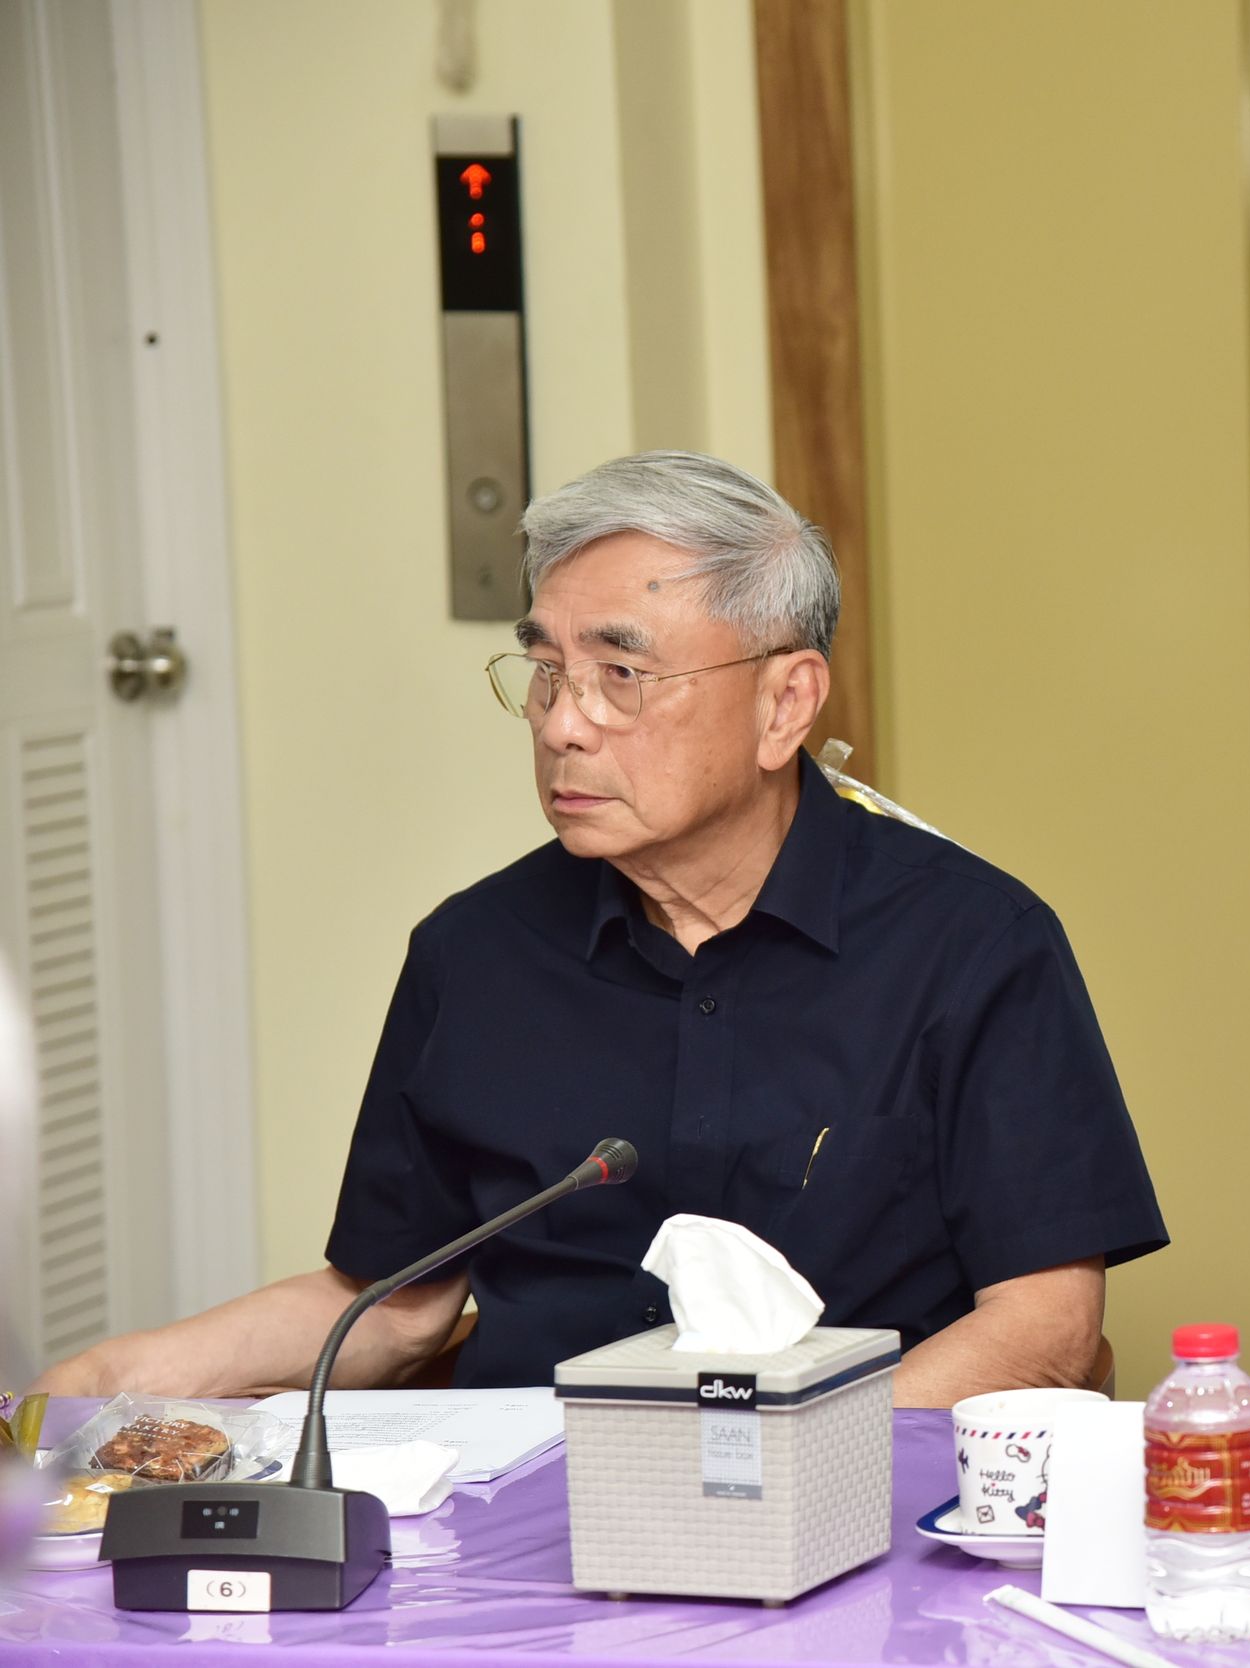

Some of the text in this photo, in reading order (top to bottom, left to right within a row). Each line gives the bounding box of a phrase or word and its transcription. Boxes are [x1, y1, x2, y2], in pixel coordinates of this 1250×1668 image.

[699, 1379, 754, 1400] dkw
[134, 1415, 190, 1429] VICTORY
[979, 1468, 1015, 1482] Hello
[981, 1482, 1016, 1503] Kitty
